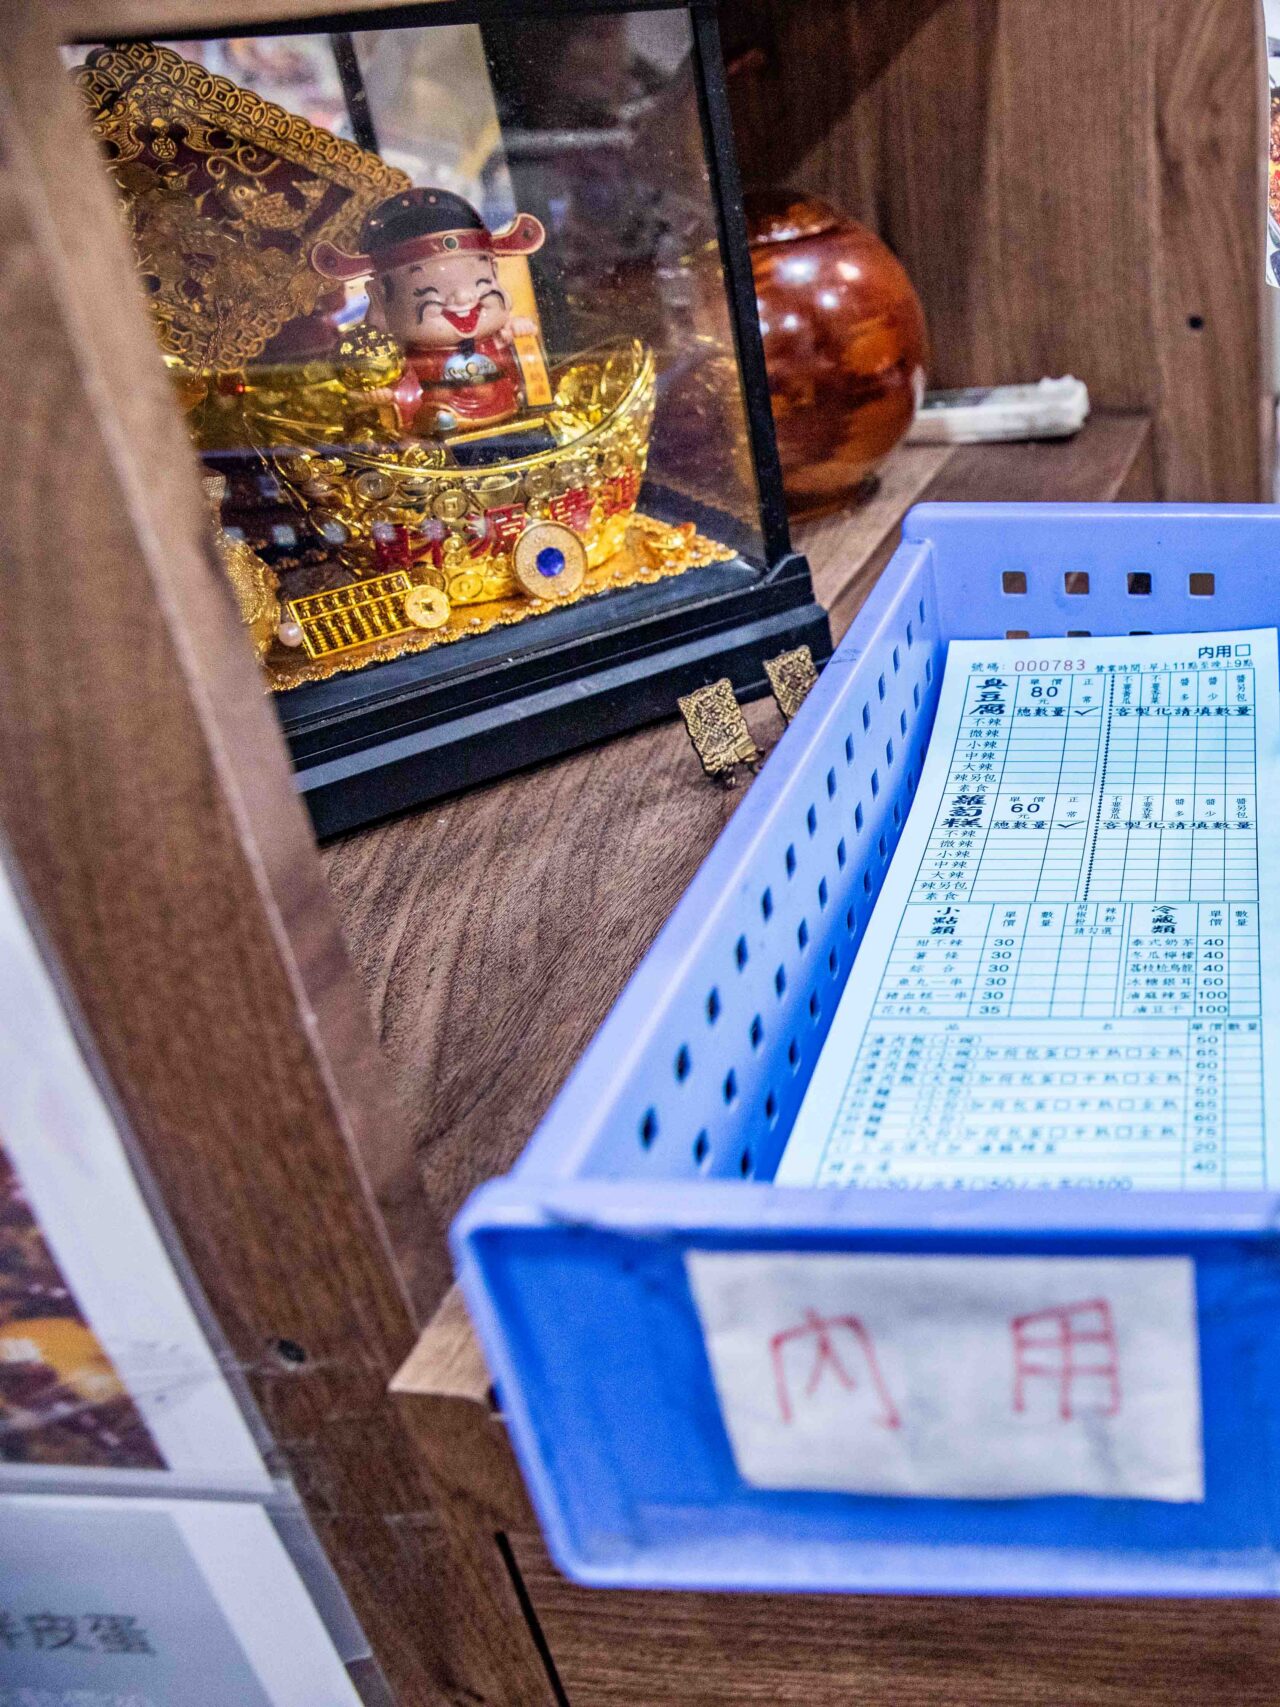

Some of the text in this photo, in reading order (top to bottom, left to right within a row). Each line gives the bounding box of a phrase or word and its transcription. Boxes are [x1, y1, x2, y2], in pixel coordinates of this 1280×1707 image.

[1014, 659, 1086, 672] 000783
[1031, 687, 1058, 697] 80
[974, 718, 1002, 726] 不辣
[969, 729, 999, 738] 微辣
[968, 741, 997, 749] 小辣
[965, 751, 995, 760] 中辣
[963, 763, 993, 771] 大辣
[1010, 803, 1041, 813] 60
[993, 938, 1015, 947] 30
[1203, 938, 1224, 947] 40
[990, 951, 1012, 960] 30
[1203, 951, 1224, 960] 40
[988, 964, 1010, 973] 30
[1203, 964, 1224, 973] 40
[985, 977, 1007, 986] 30
[1203, 977, 1224, 987] 60
[982, 991, 1004, 1001] 30
[1198, 991, 1228, 1000] 100
[979, 1006, 1001, 1015] 35
[1198, 1004, 1228, 1014] 100
